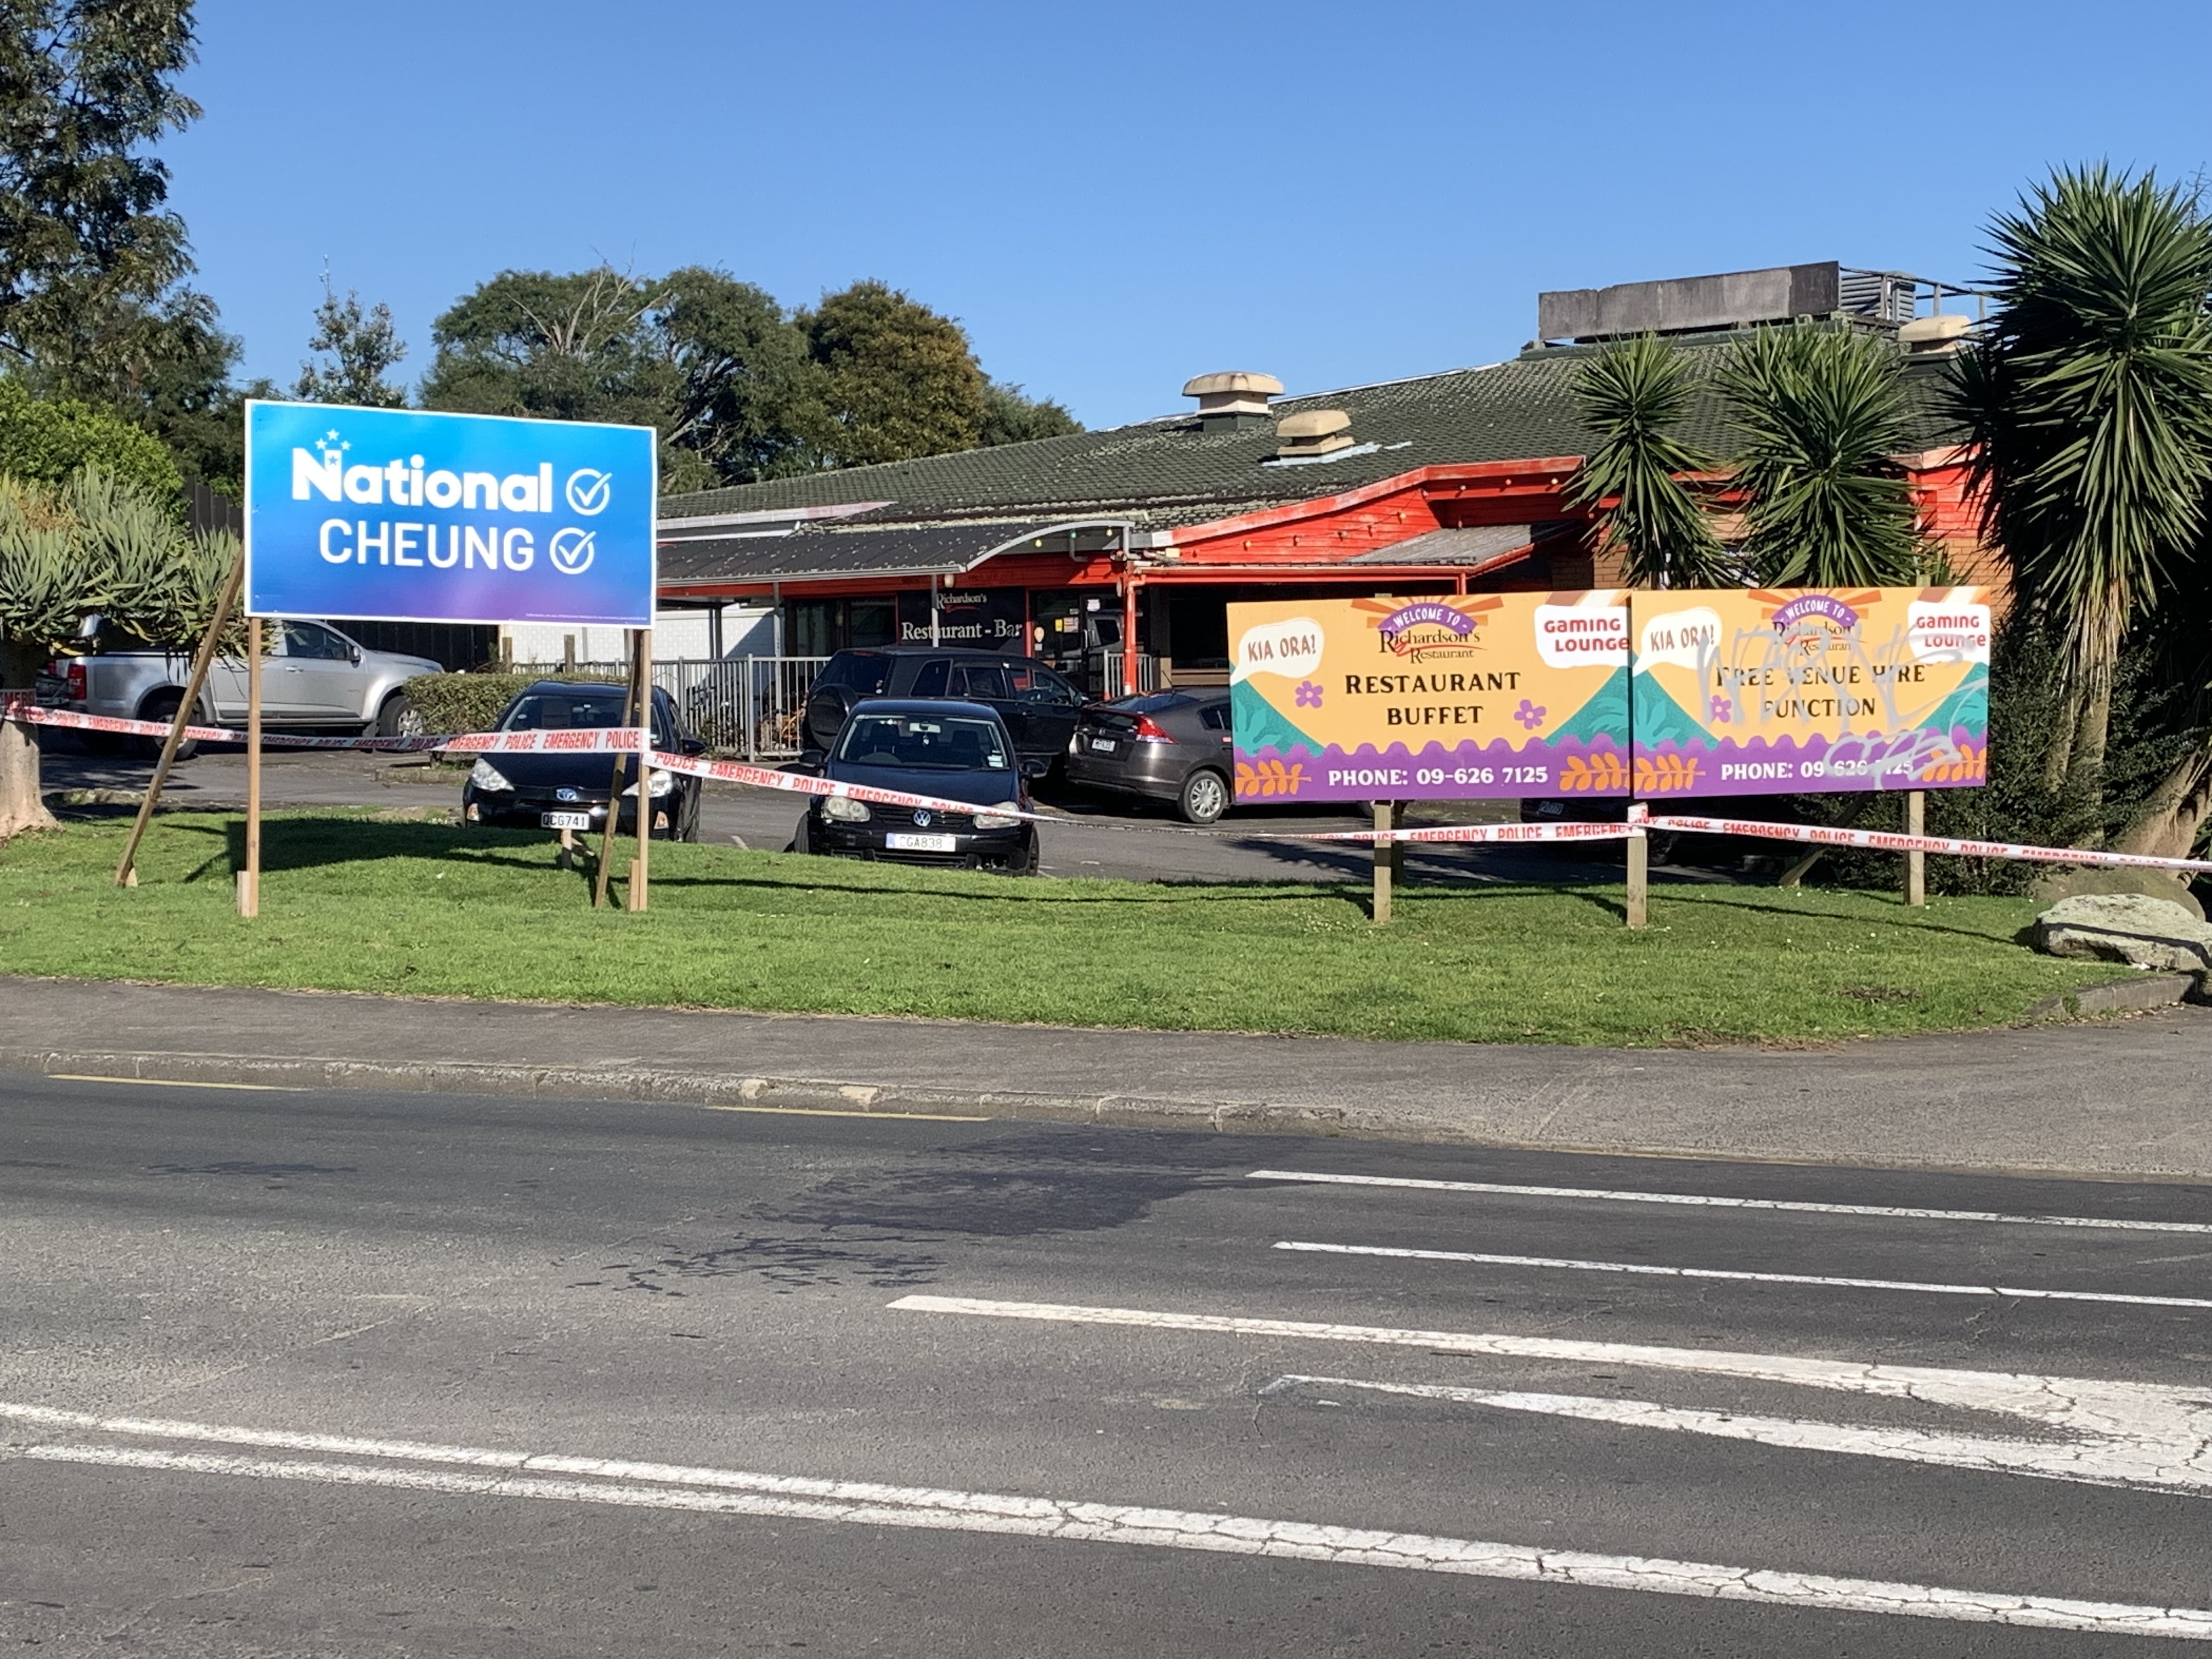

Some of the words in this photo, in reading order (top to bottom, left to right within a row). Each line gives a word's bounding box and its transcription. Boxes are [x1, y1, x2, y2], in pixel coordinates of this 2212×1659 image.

[292, 448, 552, 512] National
[320, 518, 534, 572] CHEUNG
[936, 592, 988, 610] Richardson's
[1785, 599, 1830, 620] WELCOME
[1832, 603, 1845, 618] TO
[1393, 607, 1444, 629] WELCOME
[1447, 611, 1461, 626] TO
[901, 622, 983, 640] Resturant
[994, 619, 1023, 637] Bar
[1248, 640, 1274, 662] KIA
[1280, 634, 1316, 658] ORA!
[1379, 629, 1481, 653] Richardson's
[1650, 630, 1675, 653] KIA
[1410, 647, 1474, 664] Restaurant
[1345, 672, 1521, 694] RESTAURANT
[1871, 664, 1926, 683] HRE
[1387, 706, 1484, 726] BUFFET
[1764, 697, 1876, 719] FUNCTION
[443, 735, 500, 750] EMERGENCY
[503, 733, 537, 750] POLICE
[543, 731, 600, 749] EMERGENCY
[606, 731, 639, 748] POLICE
[653, 754, 698, 771] POLICE
[708, 763, 785, 787] EMERGENCY
[793, 777, 836, 795] POLICE
[1328, 769, 1408, 786] PHONE:
[1417, 768, 1494, 785] 09-626
[1502, 766, 1548, 783] 7125
[1721, 763, 1793, 781] PHONE:
[1800, 760, 1868, 778] 09626
[1875, 759, 1914, 775] 125
[1409, 827, 1487, 841] EMERGENCY
[1497, 826, 1543, 839] POLICE
